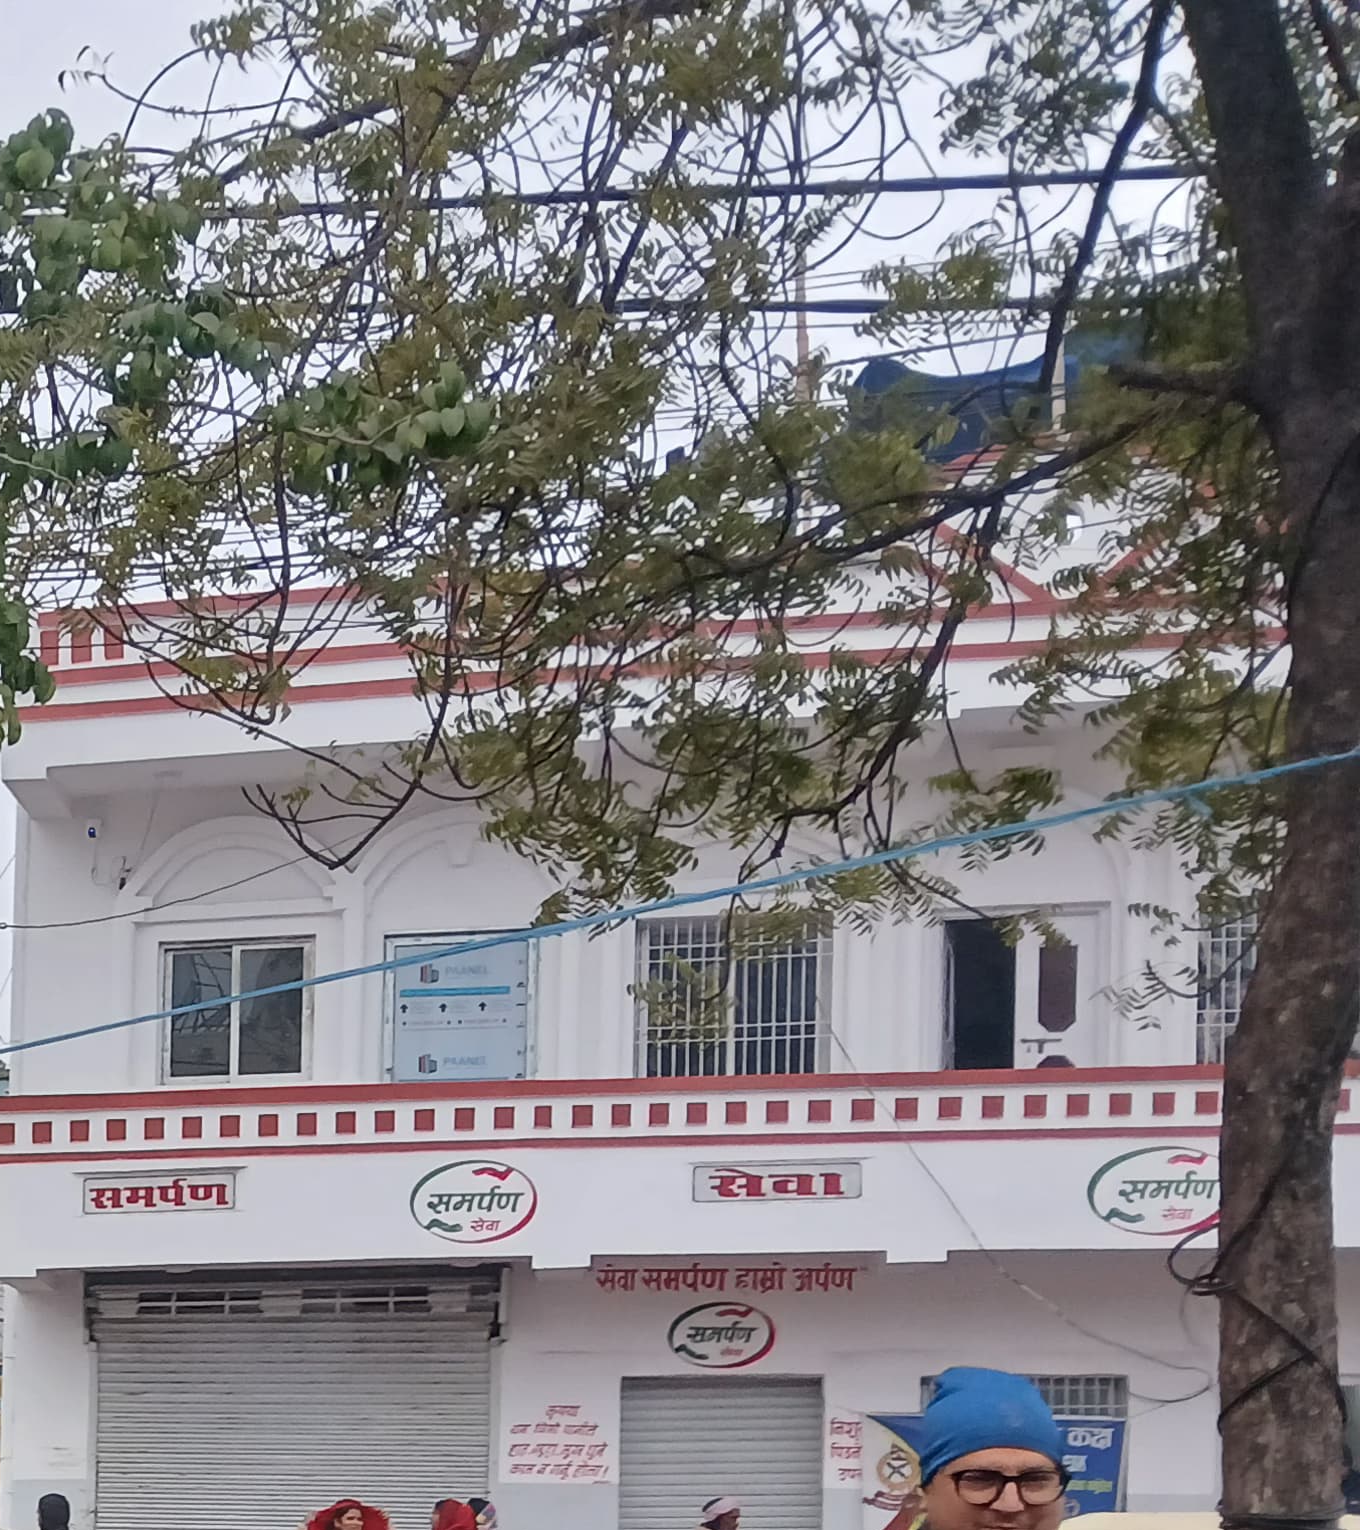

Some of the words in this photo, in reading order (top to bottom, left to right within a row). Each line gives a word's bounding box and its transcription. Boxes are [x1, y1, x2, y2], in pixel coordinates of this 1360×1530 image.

[88, 1177, 229, 1209] समर्पण
[708, 1168, 845, 1197] सेवा
[1118, 1170, 1220, 1203] समर्पण
[427, 1185, 525, 1214] समर्पण
[470, 1217, 501, 1232] सेवा
[641, 1262, 729, 1293] समर्पण
[687, 1321, 758, 1343] समर्पण
